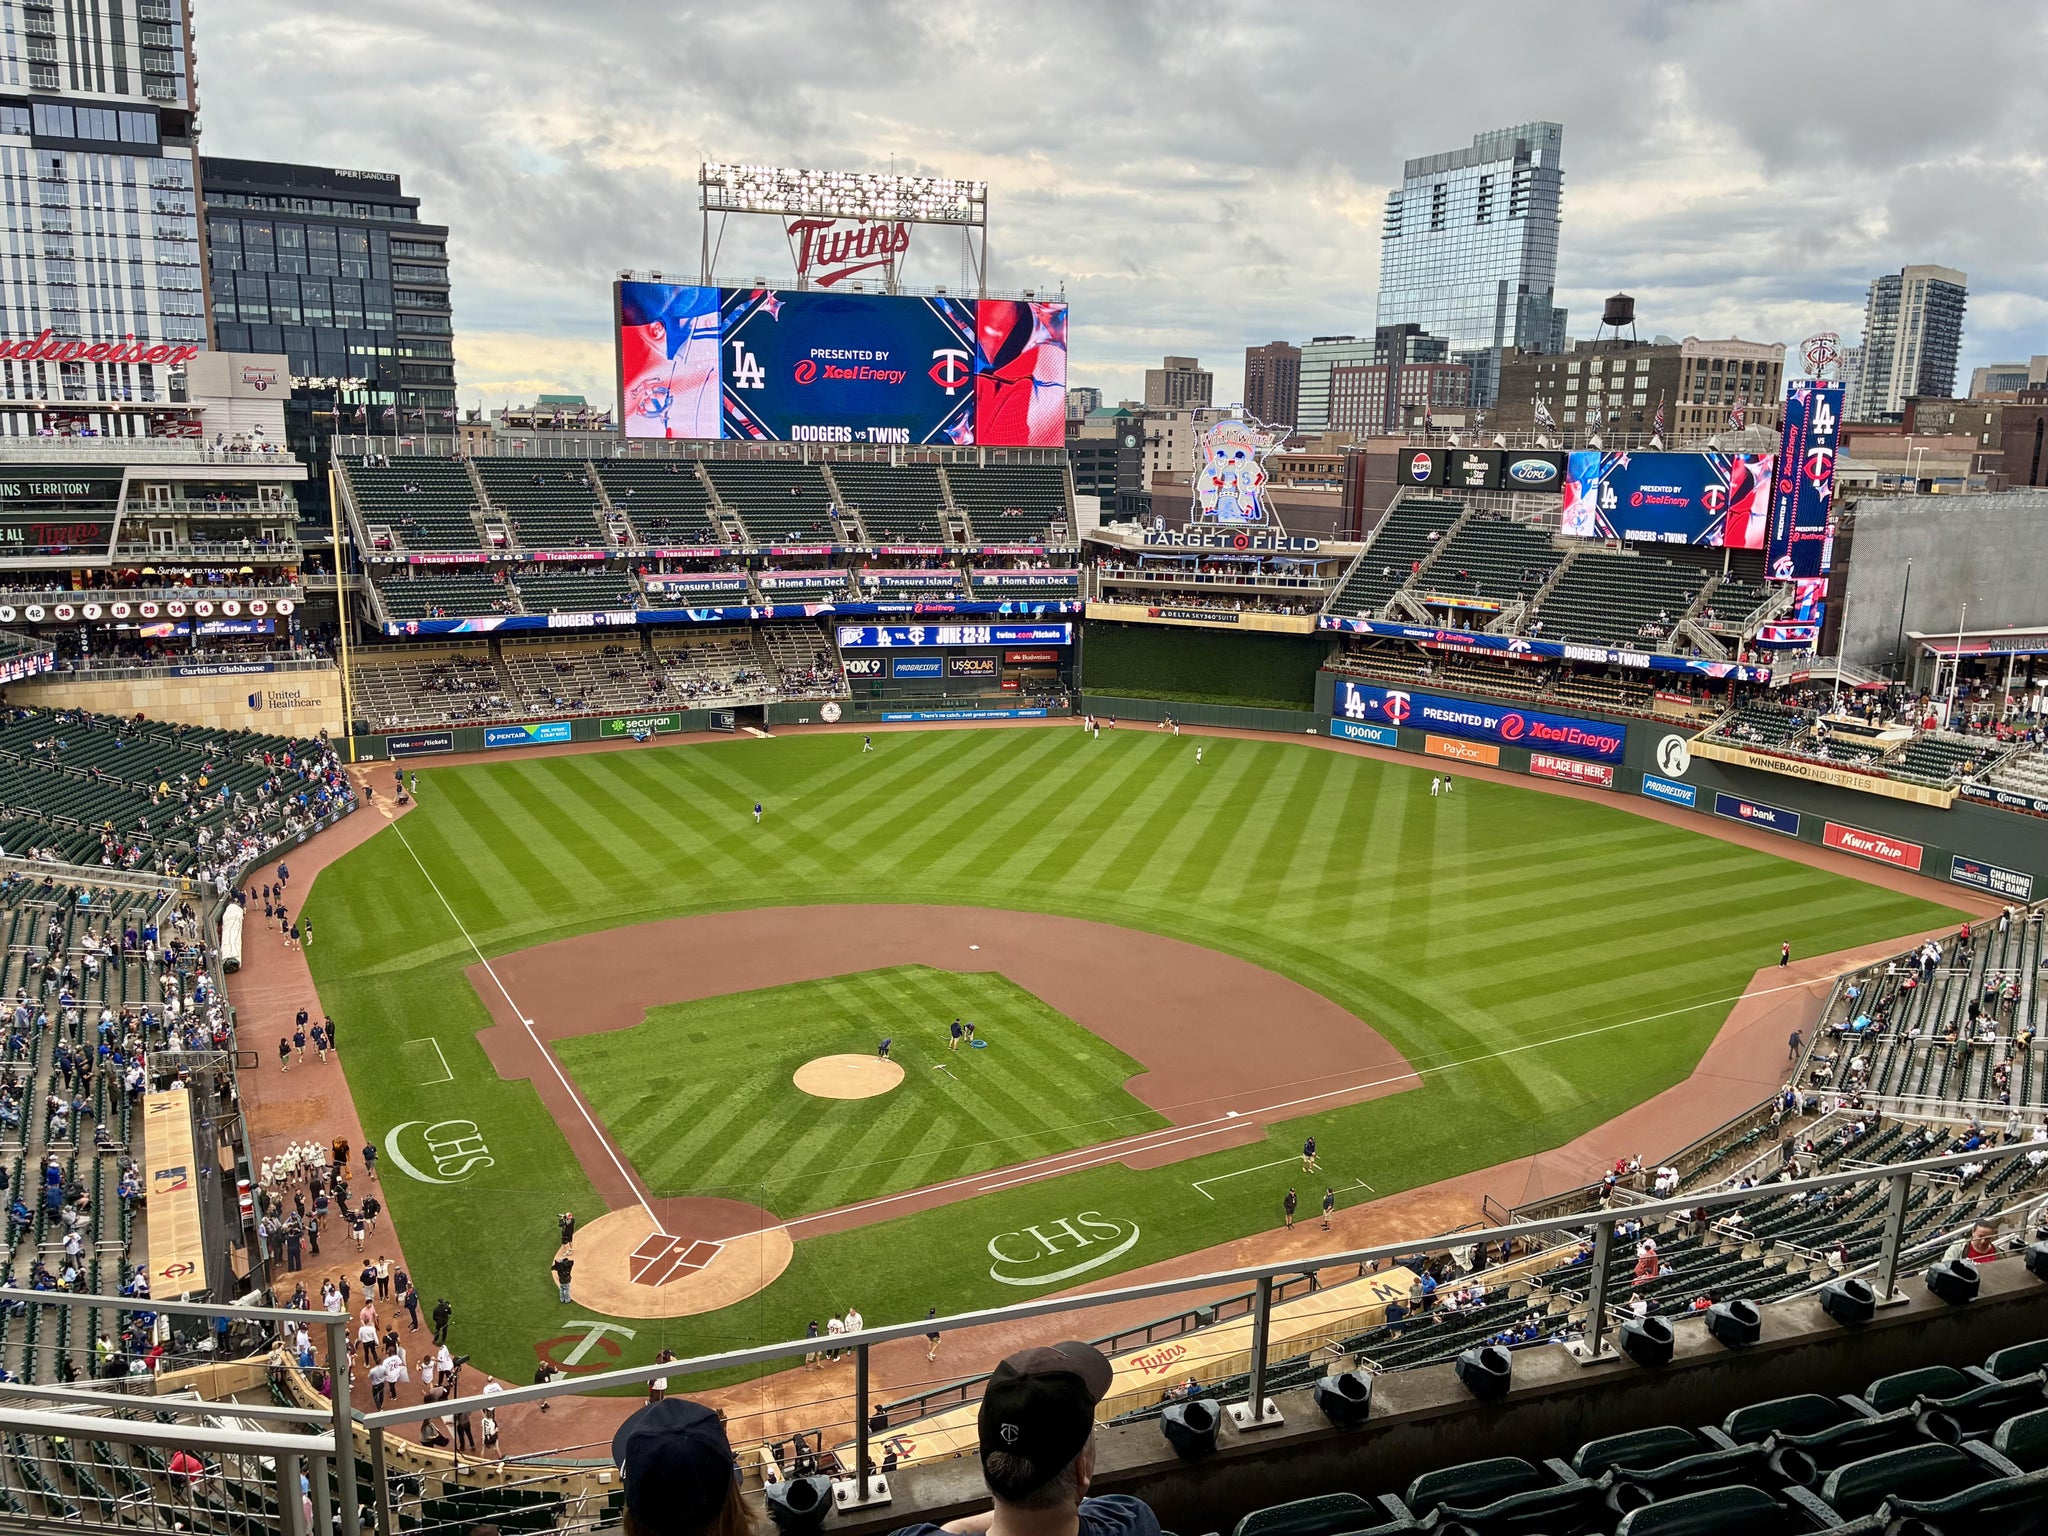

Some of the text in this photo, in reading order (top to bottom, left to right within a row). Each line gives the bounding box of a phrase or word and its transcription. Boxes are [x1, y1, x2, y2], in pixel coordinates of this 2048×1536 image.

[334, 170, 396, 182] PIPER SANDLER
[787, 215, 909, 282] Twins
[810, 348, 890, 360] PRESENTED BY
[792, 425, 852, 442] DODGERS
[867, 427, 910, 444] TWINS
[1518, 464, 1546, 479] Ford
[28, 483, 90, 494] TERRITORY
[1465, 477, 1484, 486] Tribune
[1640, 485, 1672, 493] PRESENTED
[1777, 496, 1788, 540] PRESENTED BY
[7, 529, 24, 541] ALL
[30, 523, 100, 546] Twins
[1144, 533, 1320, 550] TARGET FIELD
[1625, 530, 1687, 544] DODGERS TWINS
[669, 581, 739, 591] Treasure Island
[778, 580, 804, 588] Home
[885, 578, 924, 586] Treasure
[2, 609, 10, 618] W
[29, 609, 41, 618] 42
[59, 607, 70, 617] 36
[89, 607, 95, 616] 7
[116, 606, 125, 615] 10
[548, 614, 594, 628] DODGERS
[605, 612, 637, 625] TWINS
[936, 627, 990, 644] JUNE 22-24
[996, 630, 1060, 639] twins.com/tickets
[1438, 643, 1520, 659] UNIVERSAL SPORTS AUCTIONS
[1564, 645, 1650, 668] DODGERS TWINS
[180, 664, 265, 676] Carbliss Clubhouse
[845, 661, 880, 673] FOX 9
[268, 690, 300, 700] United
[268, 699, 322, 709] Healthcare
[626, 716, 670, 728] securian
[1424, 707, 1499, 729] PRESENTED BY
[496, 732, 526, 740] PENTAIR
[1345, 724, 1382, 741] uponor
[393, 739, 448, 749] twins.com/tickets
[1444, 743, 1479, 758] Paycor
[1546, 758, 1571, 772] PLACE
[1585, 764, 1605, 778] HERE
[1749, 756, 1872, 789] WINNEBAGO INDUSTRIES
[1645, 780, 1694, 800] PROGRESSIVE
[1962, 784, 1990, 798] Corona
[1997, 792, 2026, 806] Corona
[1753, 806, 1776, 822] bank
[1953, 868, 1976, 879] COMMUNITY
[1990, 869, 2030, 888] CHANGING
[1990, 879, 2028, 897] THE GAME
[424, 1120, 495, 1176] CHS
[988, 1211, 1121, 1263] CHS
[1130, 1344, 1187, 1375] Twins
